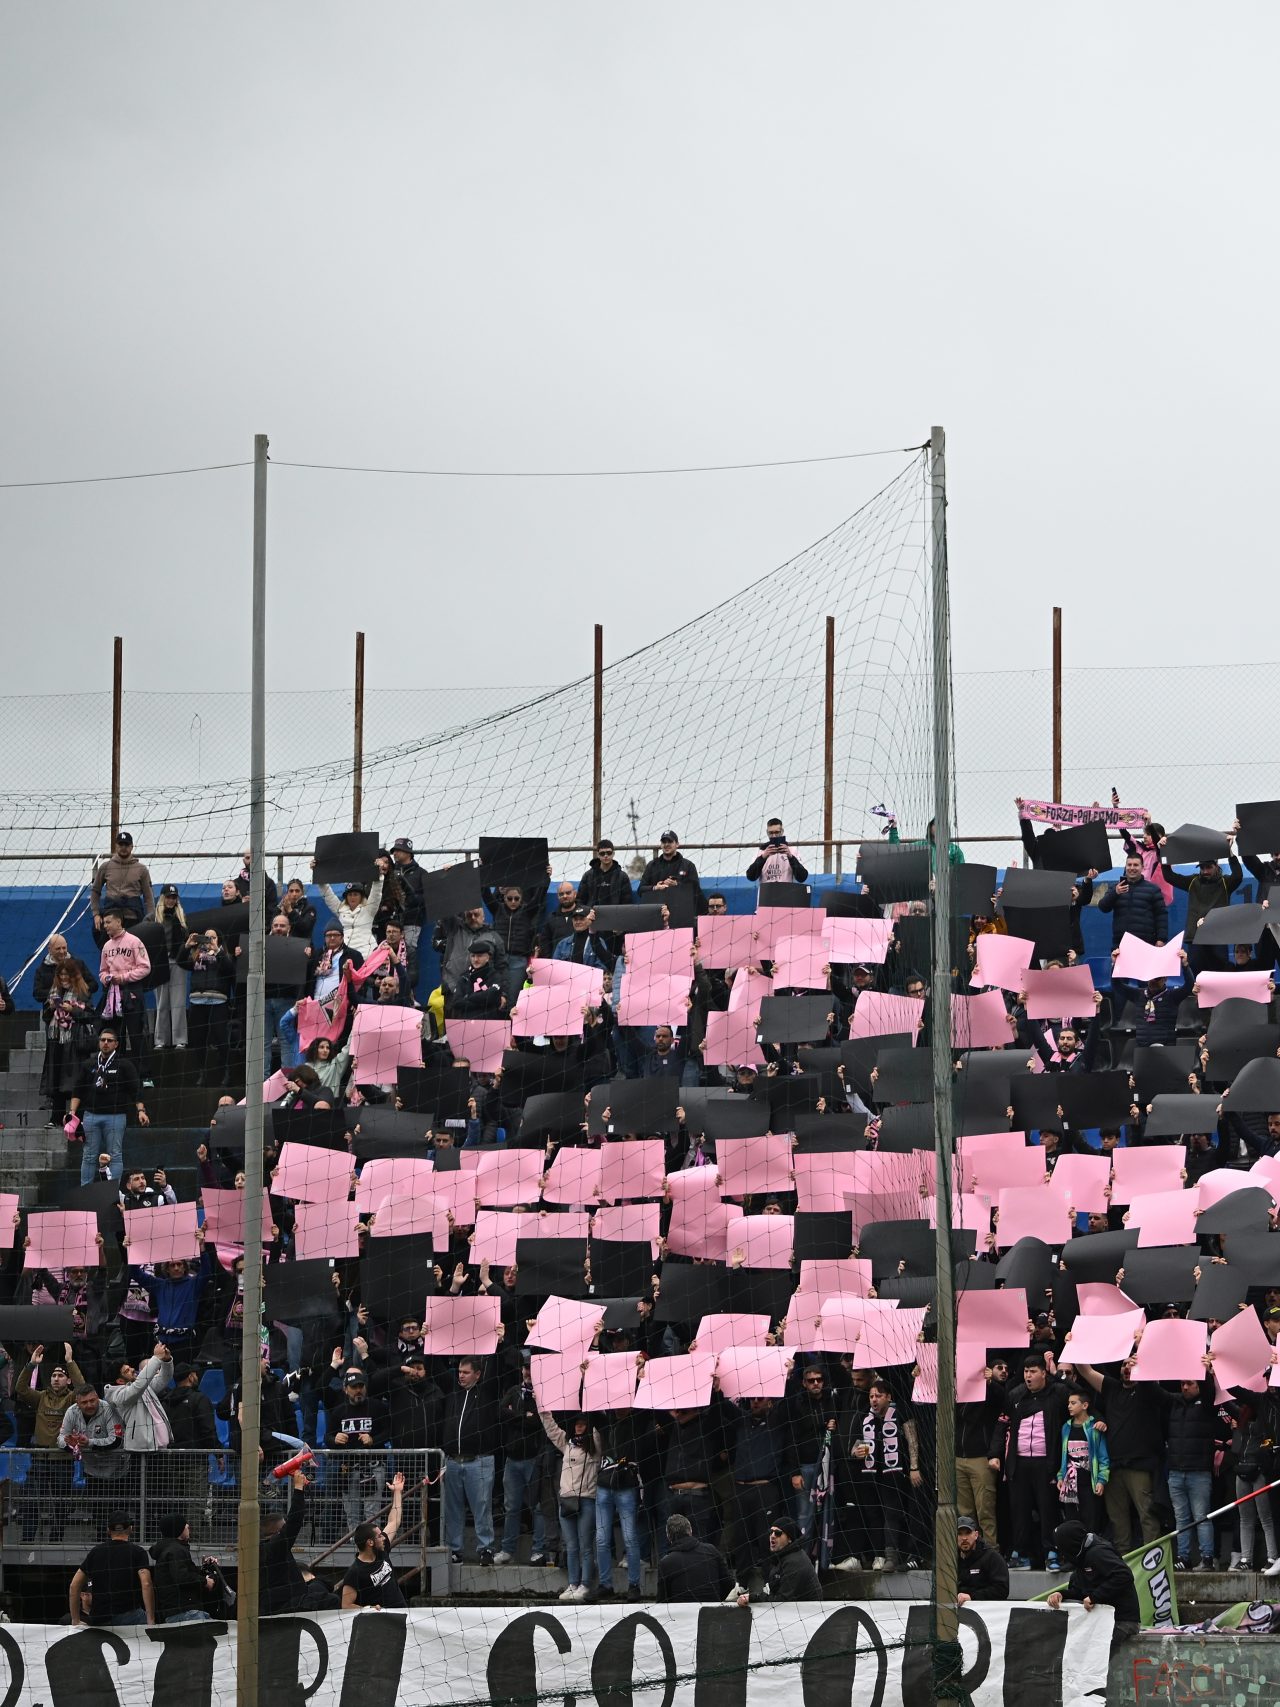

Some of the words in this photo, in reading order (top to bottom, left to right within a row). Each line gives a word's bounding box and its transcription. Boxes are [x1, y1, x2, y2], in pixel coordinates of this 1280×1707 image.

[16, 1112, 28, 1126] 11
[341, 1420, 356, 1433] LA
[359, 1419, 373, 1431] 12
[862, 1406, 876, 1469] CURV
[881, 1406, 899, 1468] NORD
[486, 1605, 1069, 1707] COLORI
